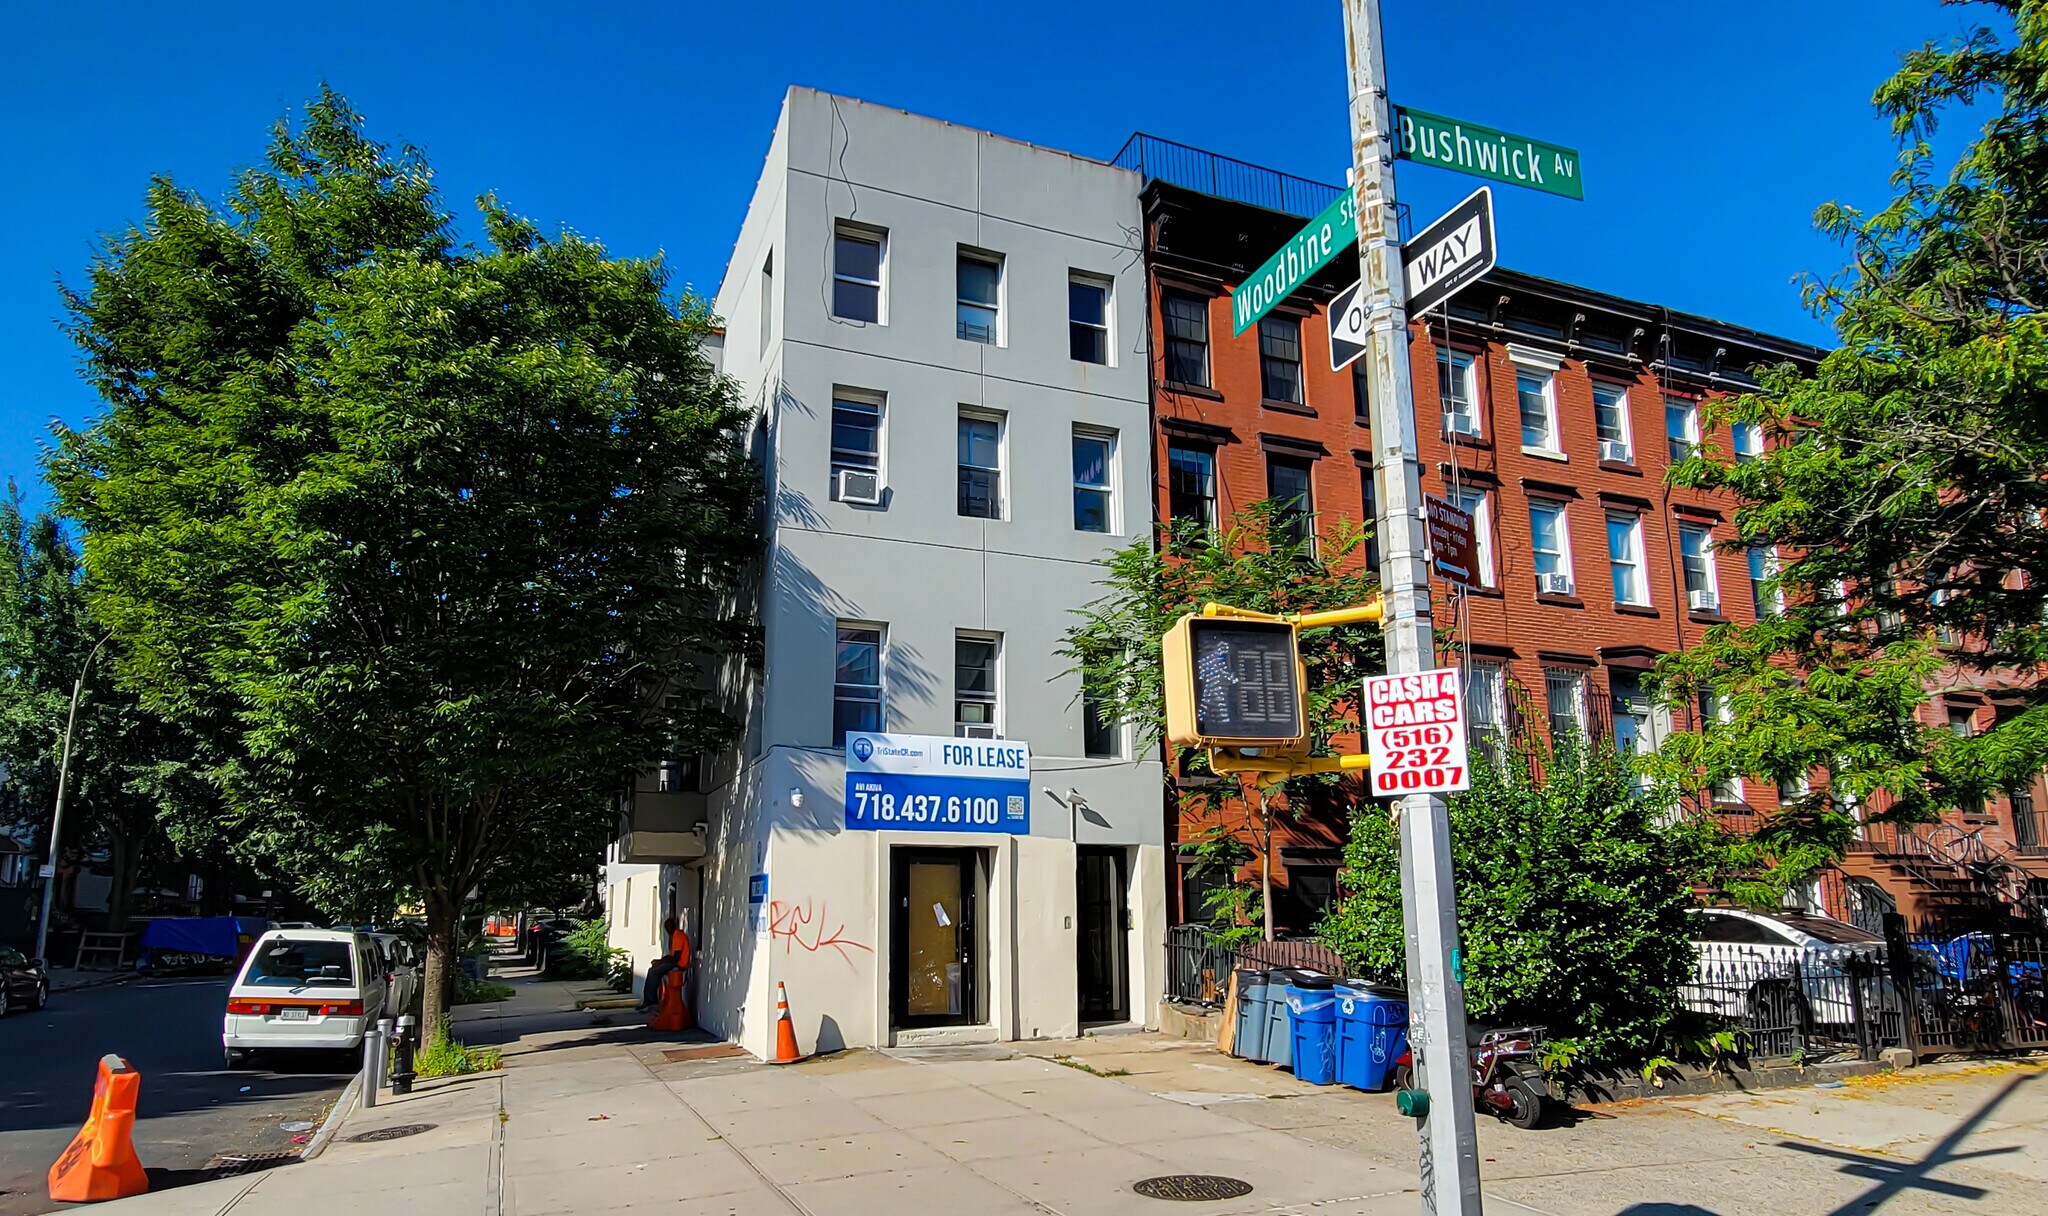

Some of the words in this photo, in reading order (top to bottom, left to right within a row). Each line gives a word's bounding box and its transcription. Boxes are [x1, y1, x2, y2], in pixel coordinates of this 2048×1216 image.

[1399, 114, 1544, 184] Bushwick
[1554, 153, 1574, 178] Av
[1236, 223, 1332, 327] Woodbine
[1340, 198, 1354, 226] St
[1418, 223, 1473, 286] WAY
[1428, 502, 1438, 520] NO
[1439, 507, 1468, 531] STANDING
[1430, 522, 1450, 542] Monday
[1452, 530, 1467, 549] Friday
[1441, 674, 1455, 696] 4
[1373, 698, 1457, 728] CARS
[1381, 724, 1454, 750] (516)
[943, 744, 974, 766] FOR
[977, 746, 1026, 770] LEASE
[1386, 747, 1451, 770] 232
[1378, 766, 1463, 791] 0007
[854, 793, 1000, 825] 718.437.6100
